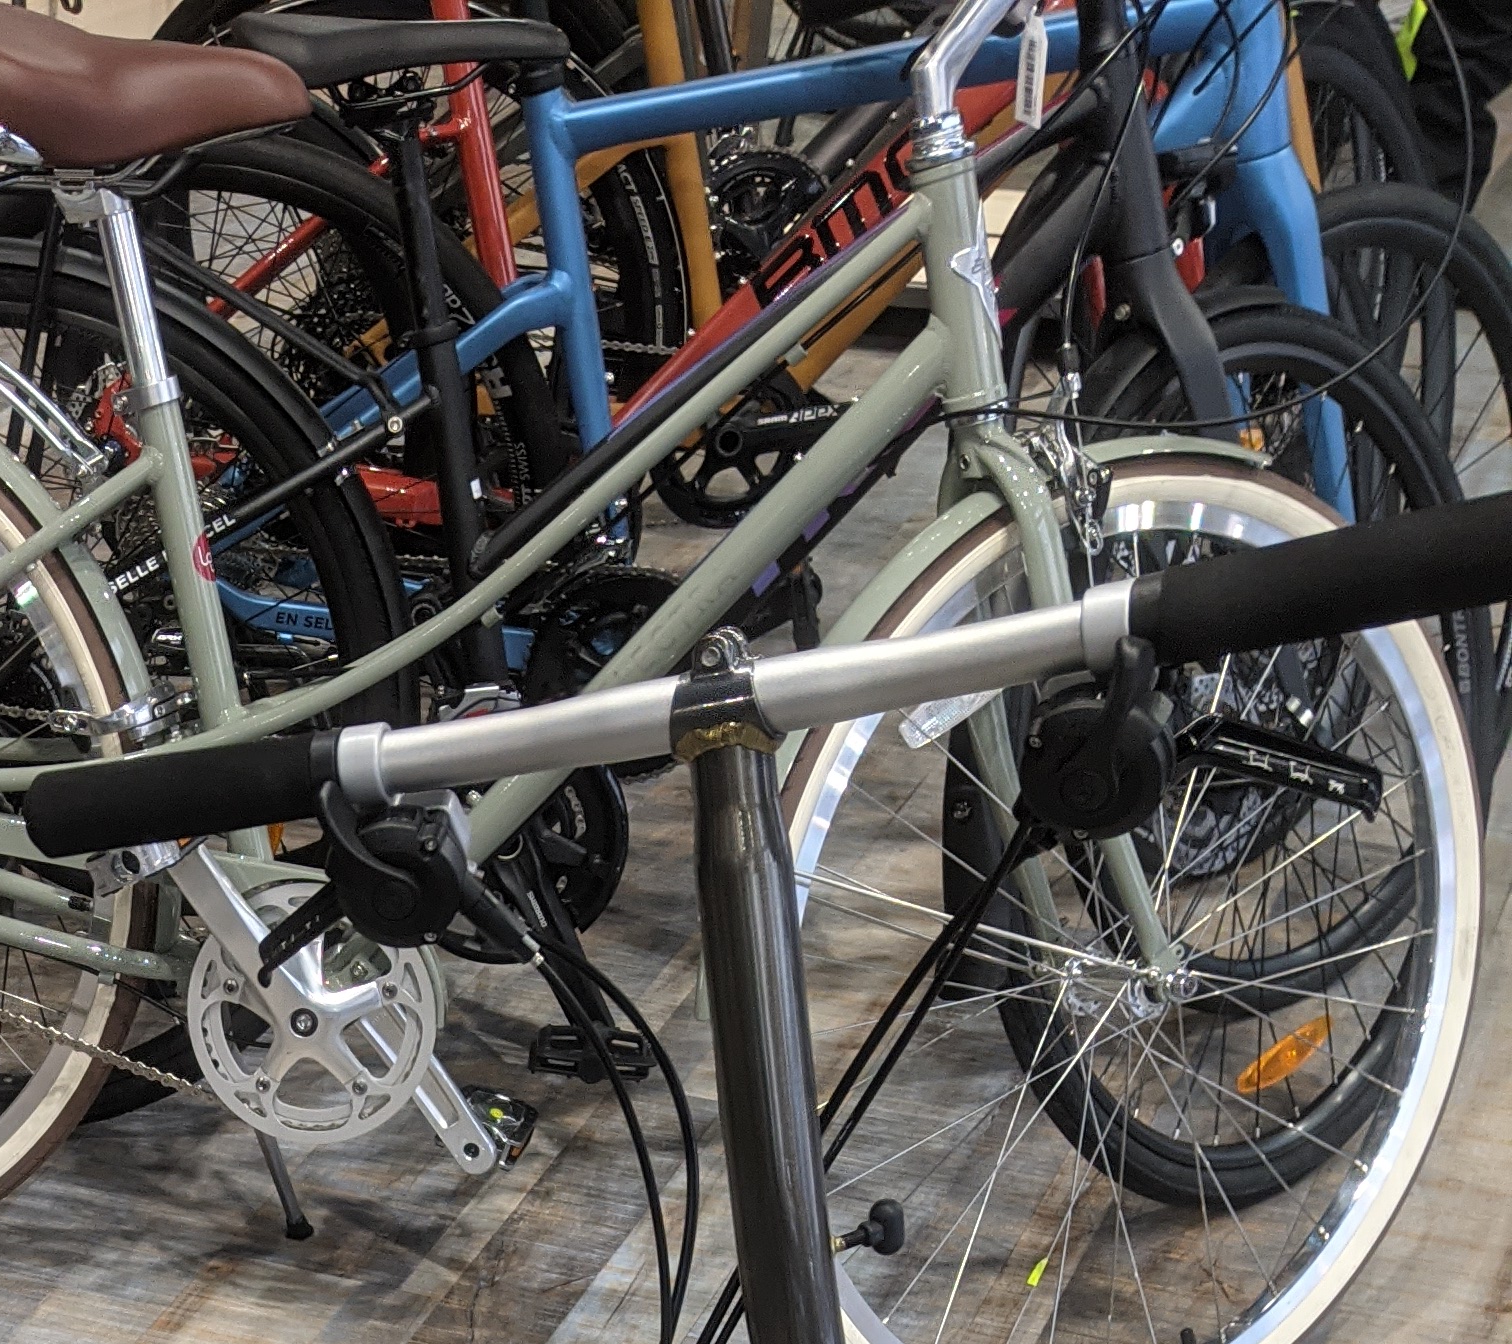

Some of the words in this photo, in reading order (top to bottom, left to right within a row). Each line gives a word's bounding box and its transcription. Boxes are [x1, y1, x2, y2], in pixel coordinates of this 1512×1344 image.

[205, 513, 237, 538] CEL
[275, 610, 298, 626] EN
[303, 615, 333, 631] SEL
